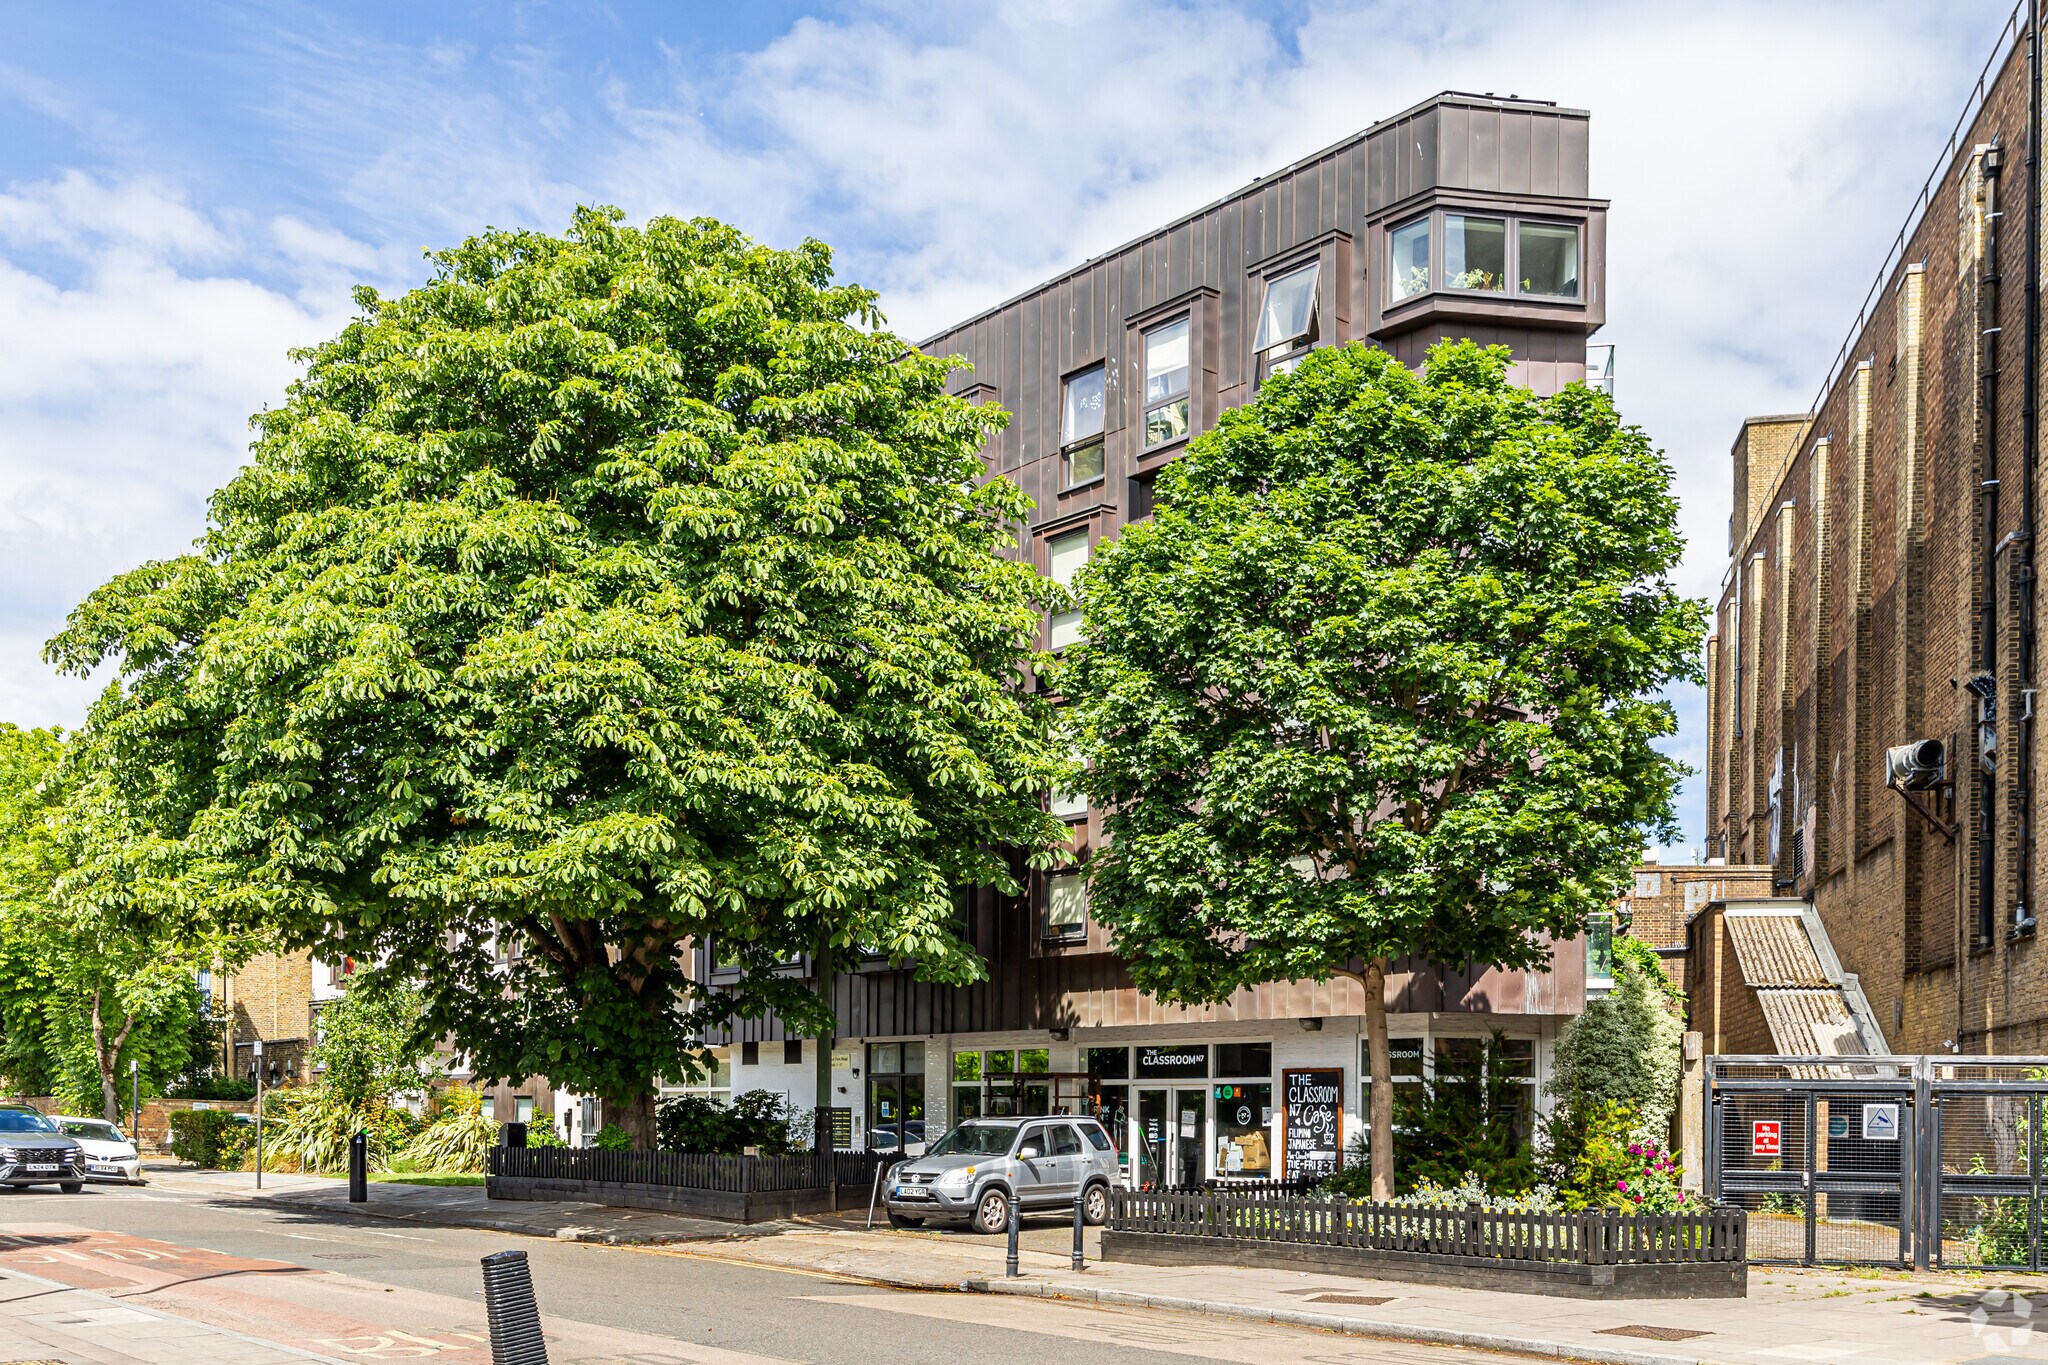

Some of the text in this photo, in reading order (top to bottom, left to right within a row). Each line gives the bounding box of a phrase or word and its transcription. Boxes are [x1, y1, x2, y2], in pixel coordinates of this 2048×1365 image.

[1142, 1054, 1205, 1066] CLASSROOM N7
[1289, 1074, 1312, 1086] THE
[1288, 1086, 1338, 1103] CLASSROOM
[1289, 1103, 1302, 1117] N7
[1303, 1104, 1335, 1133] Cafe
[1288, 1138, 1317, 1150] JAPANESE
[1287, 1159, 1316, 1170] TUE-FRI
